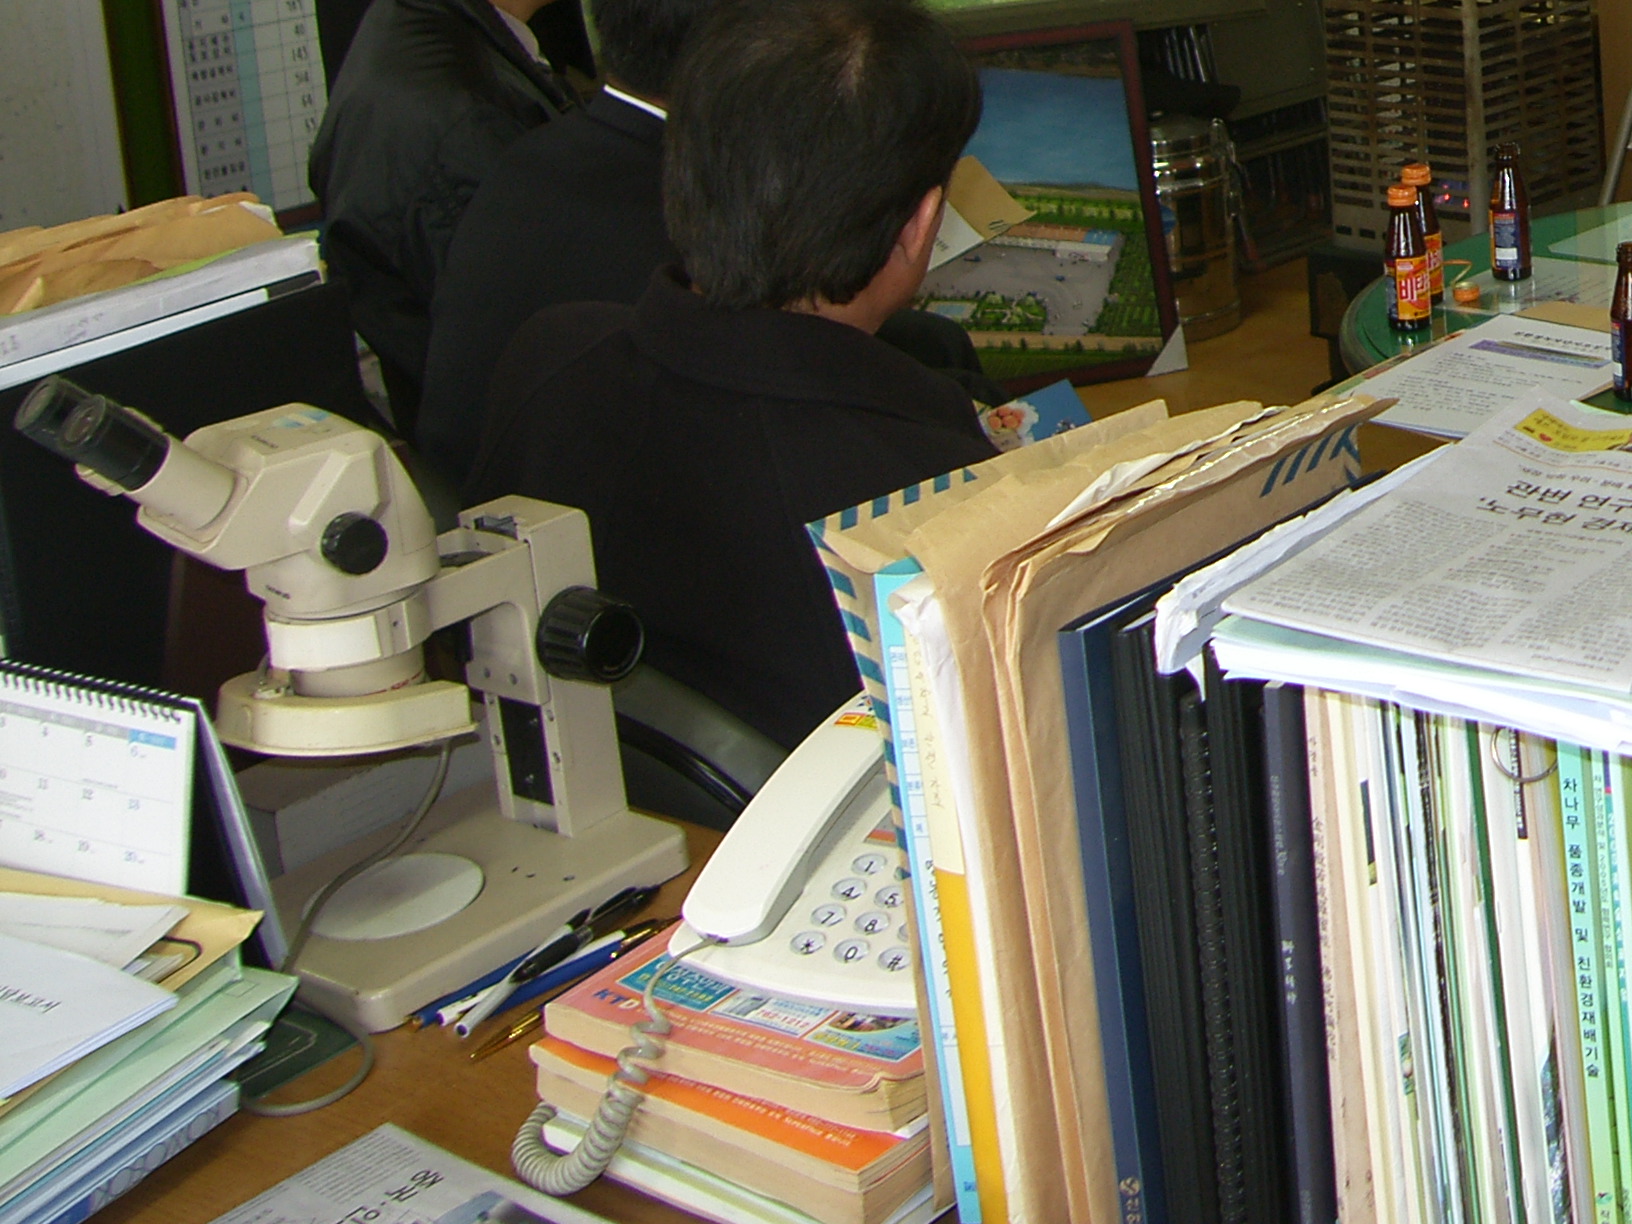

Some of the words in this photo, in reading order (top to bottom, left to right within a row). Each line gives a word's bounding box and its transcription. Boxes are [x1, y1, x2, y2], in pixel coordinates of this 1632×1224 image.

[1562, 777, 1581, 830] 차나무
[1568, 843, 1588, 914] 품종개발
[1575, 926, 1589, 943] 및
[1577, 955, 1600, 1079] 친환경재배기술
